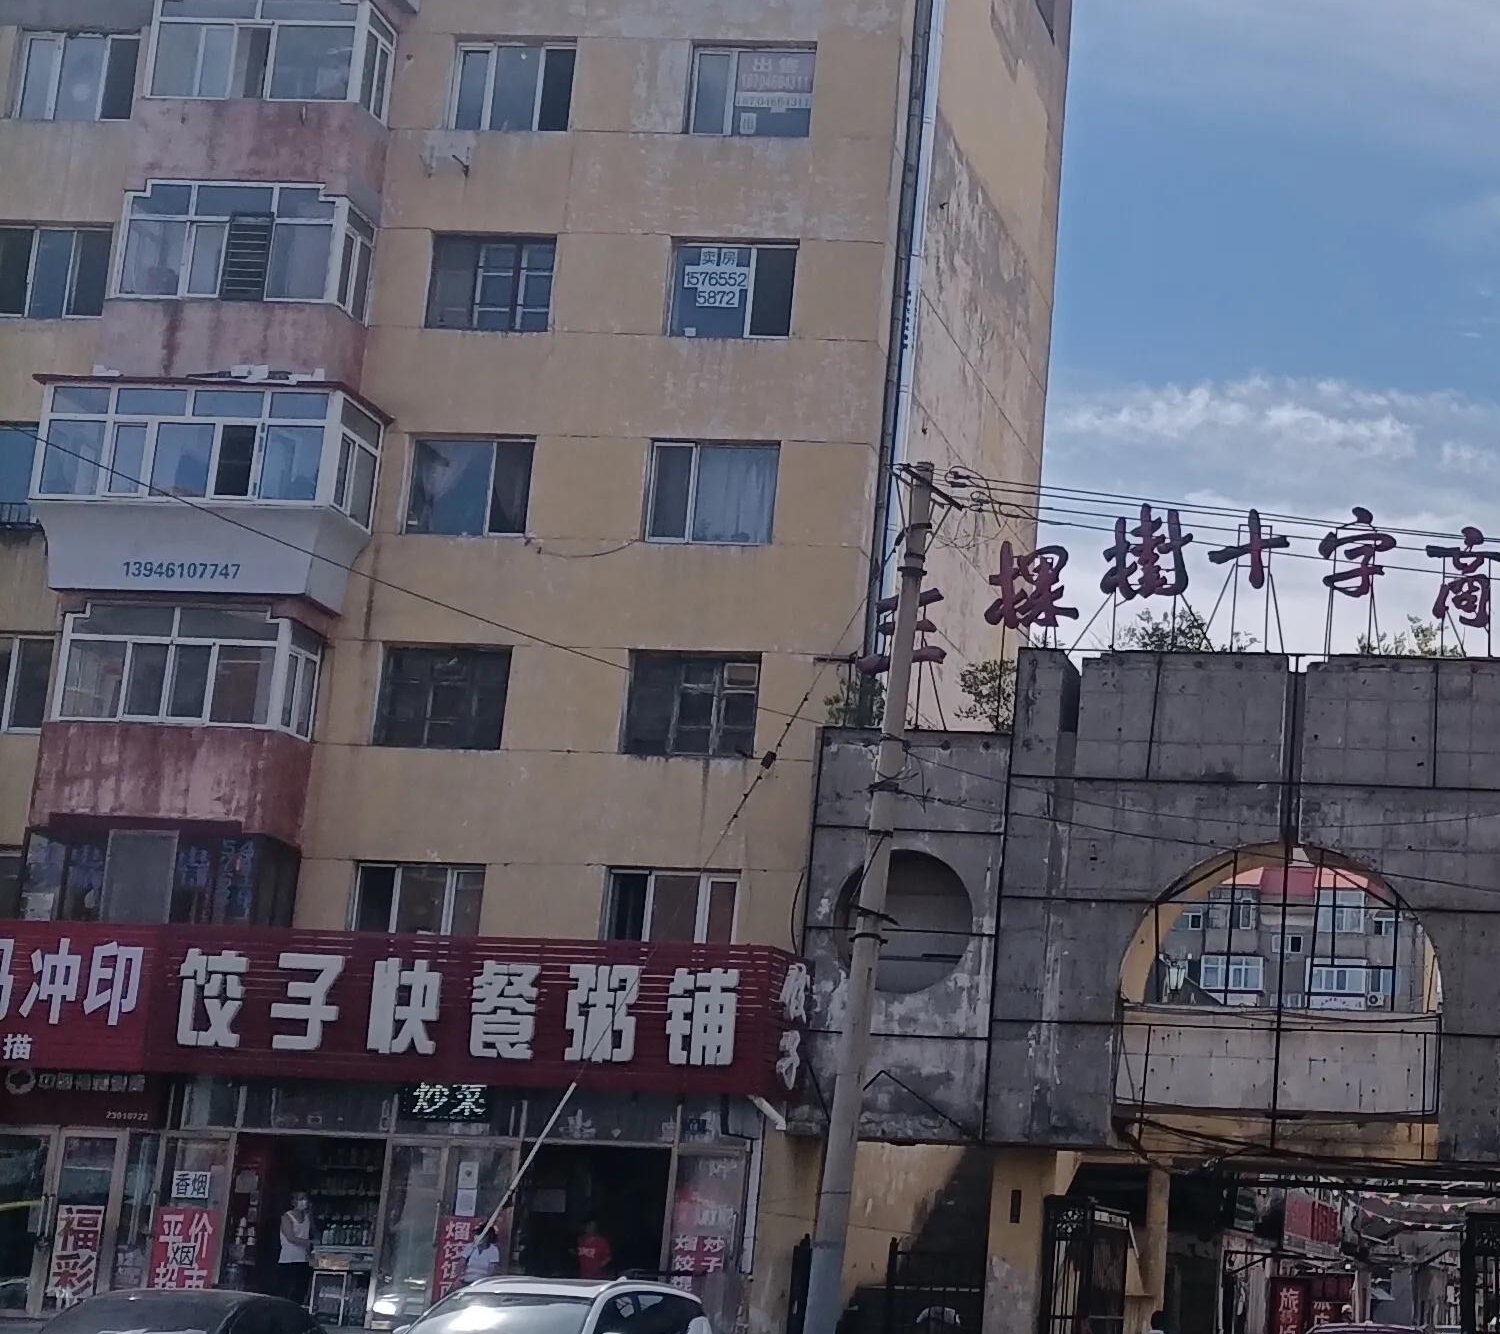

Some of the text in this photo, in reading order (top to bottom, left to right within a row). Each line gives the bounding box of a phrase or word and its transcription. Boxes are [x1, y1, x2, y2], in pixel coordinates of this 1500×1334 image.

[686, 271, 747, 287] 1576552
[696, 290, 736, 305] 5872
[123, 561, 240, 579] 13946107747
[177, 948, 741, 1066] 饺子快餐粥铺
[3, 1033, 33, 1060] 描
[175, 1172, 207, 1197] 香烟
[52, 1207, 102, 1297] 福彩
[171, 1244, 196, 1267] 烟
